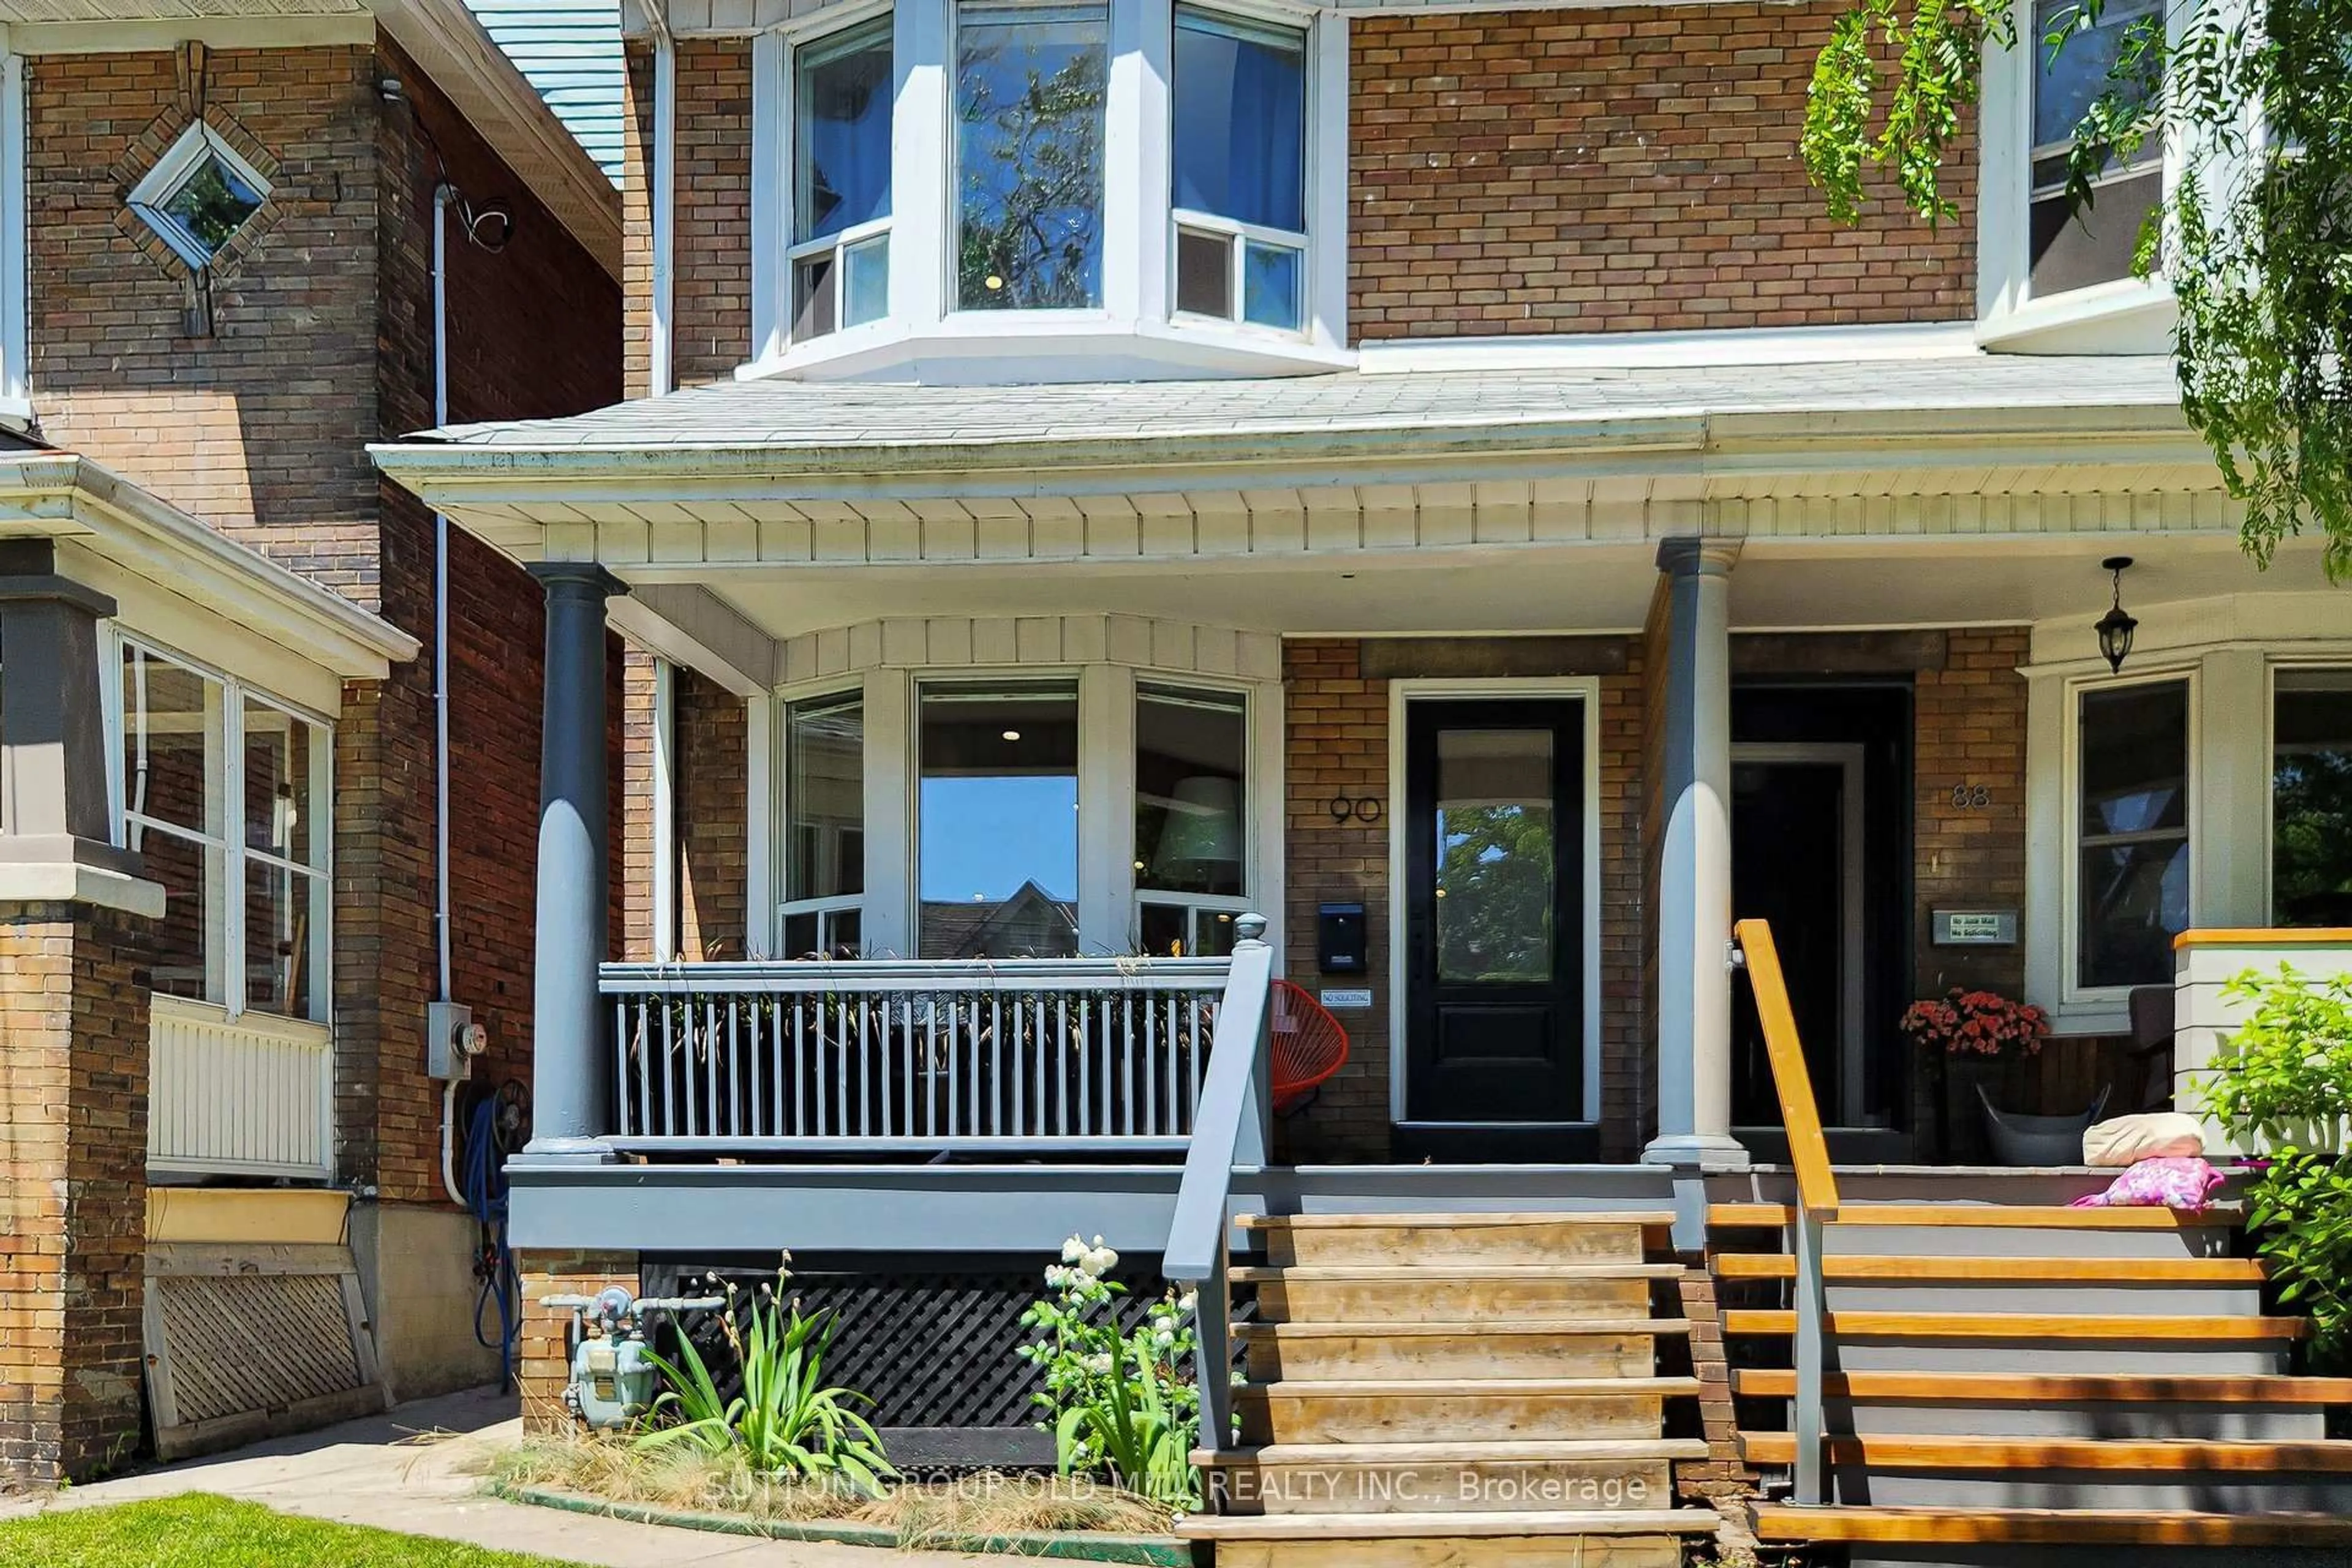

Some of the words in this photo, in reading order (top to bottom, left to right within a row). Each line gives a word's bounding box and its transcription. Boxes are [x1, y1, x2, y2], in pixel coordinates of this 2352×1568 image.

[1952, 785, 1989, 810] 88
[1330, 797, 1382, 824] 90
[1324, 993, 1333, 1001] NO
